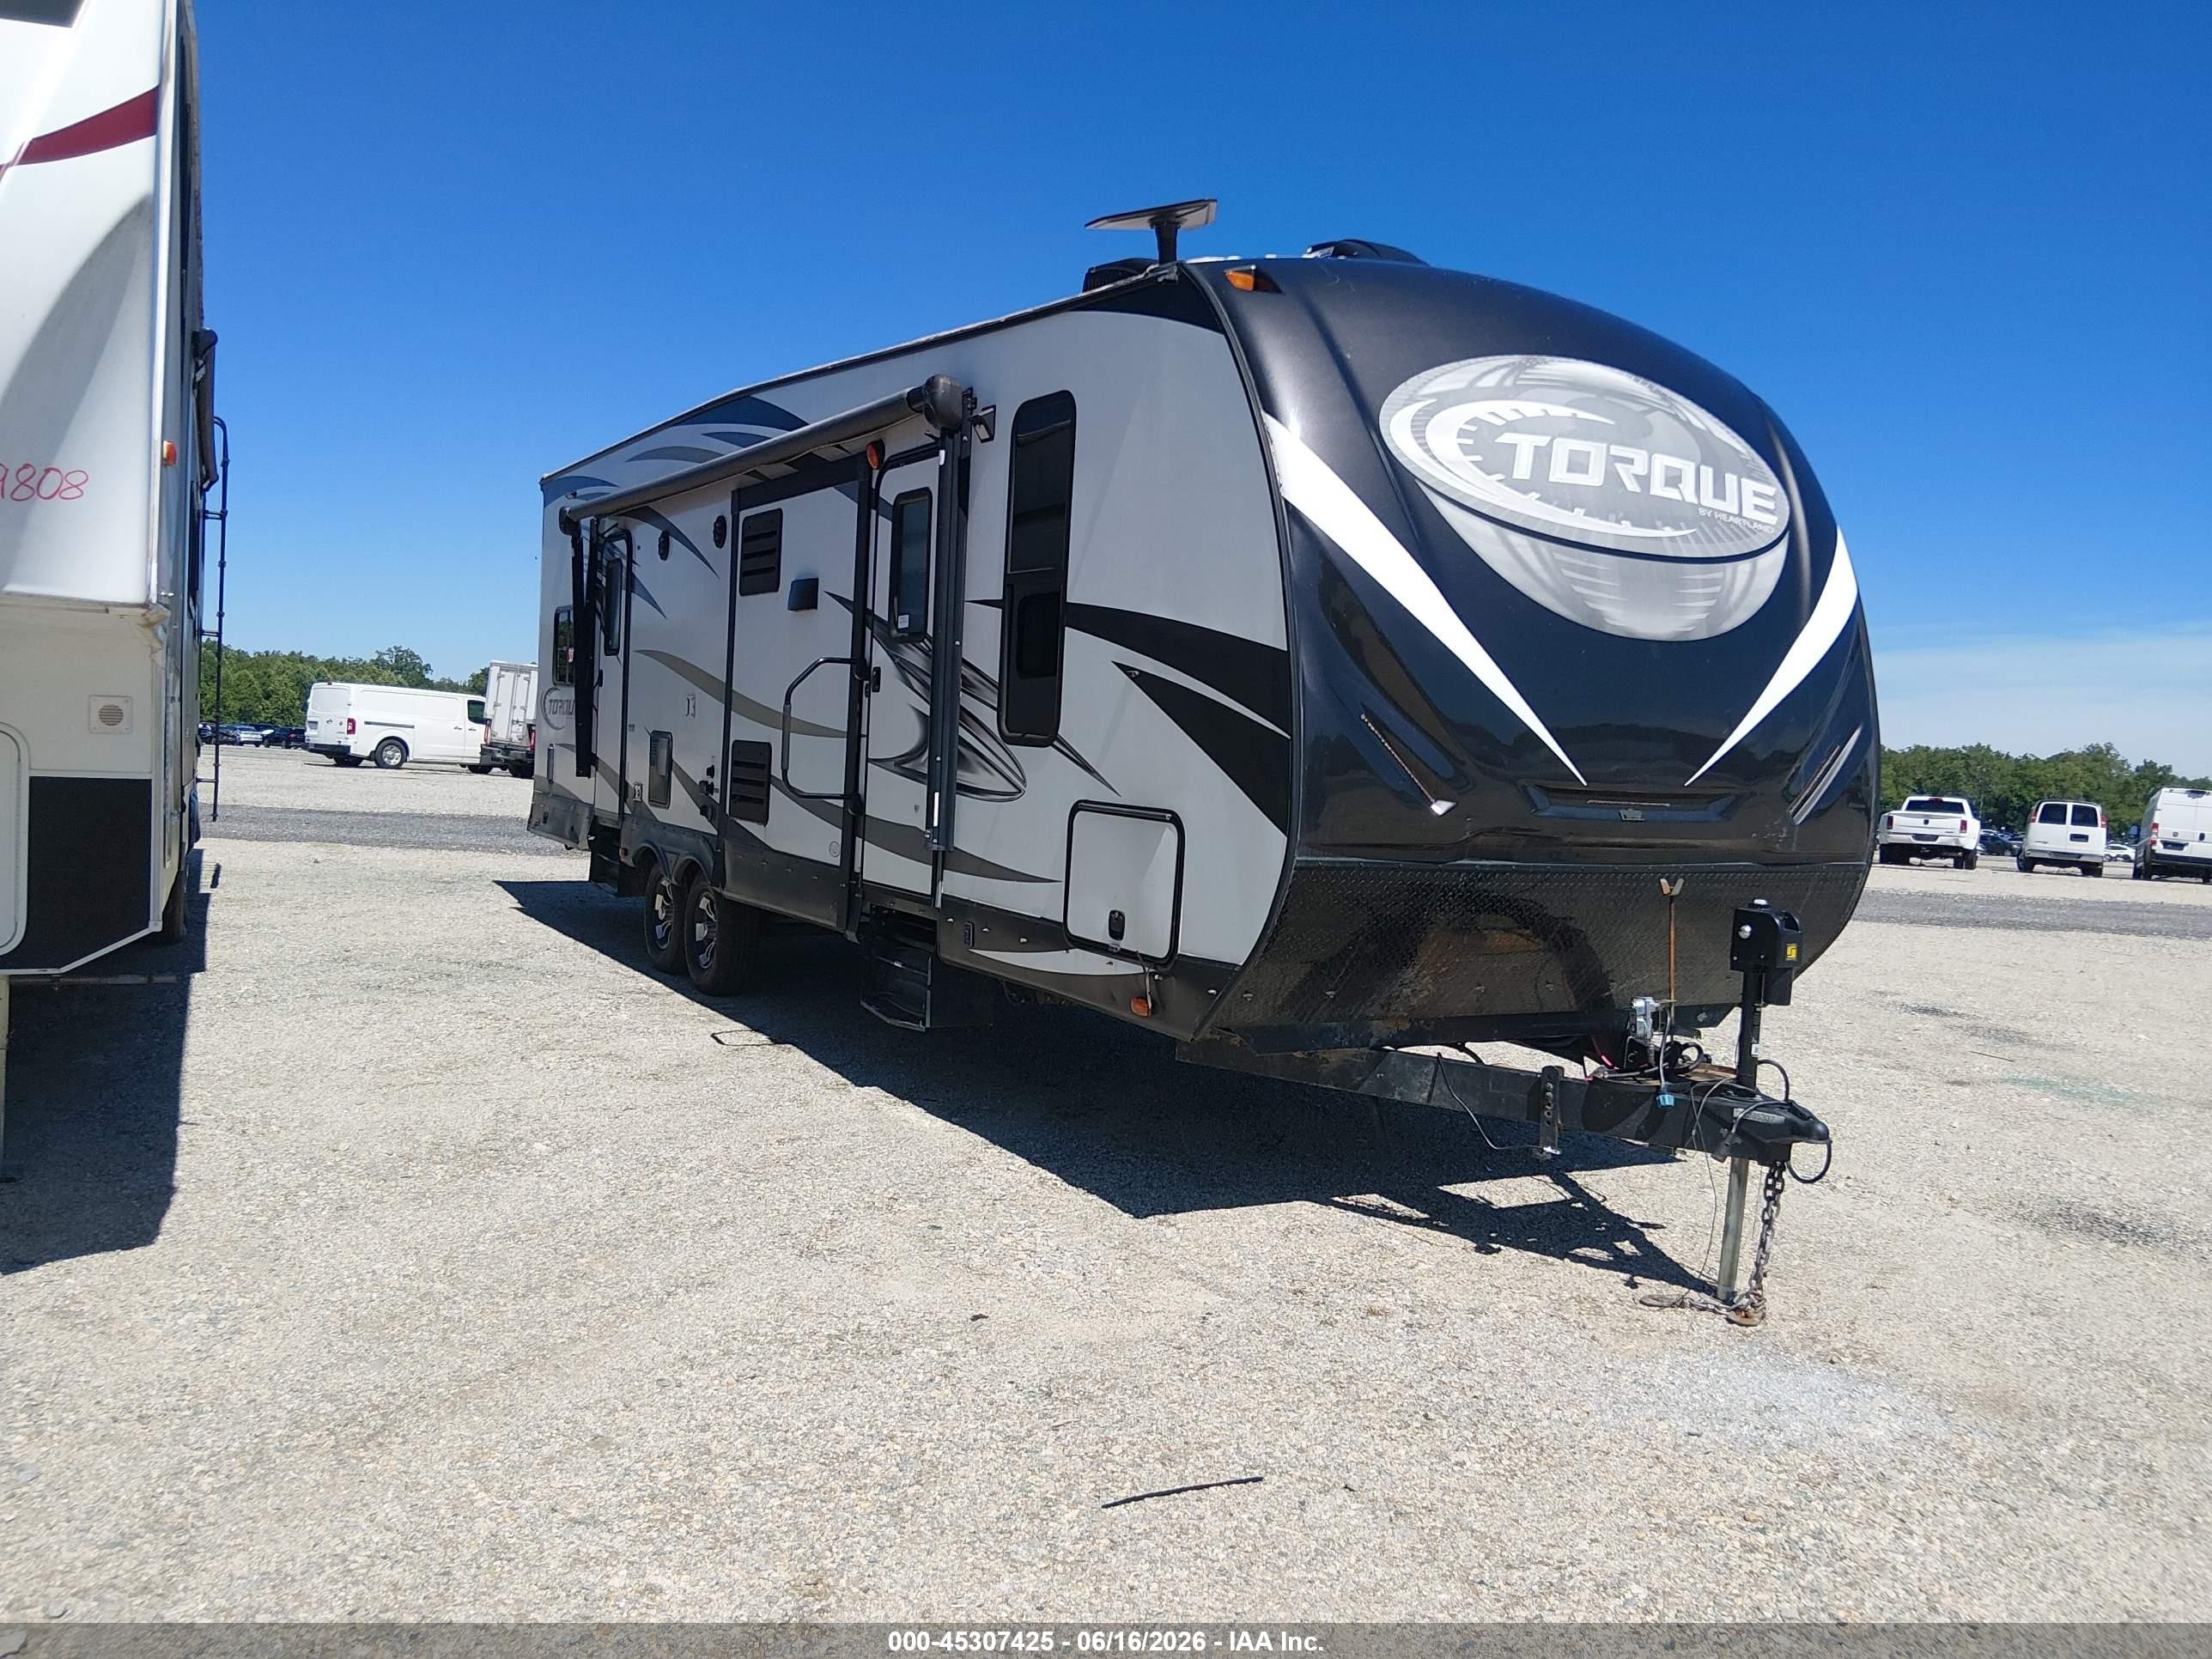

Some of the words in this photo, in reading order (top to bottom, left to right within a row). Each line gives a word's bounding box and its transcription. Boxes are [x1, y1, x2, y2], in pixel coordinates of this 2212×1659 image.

[1494, 432, 1779, 526] TORQUE
[1714, 511, 1775, 534] HEARTLAND
[550, 699, 575, 715] TORQU
